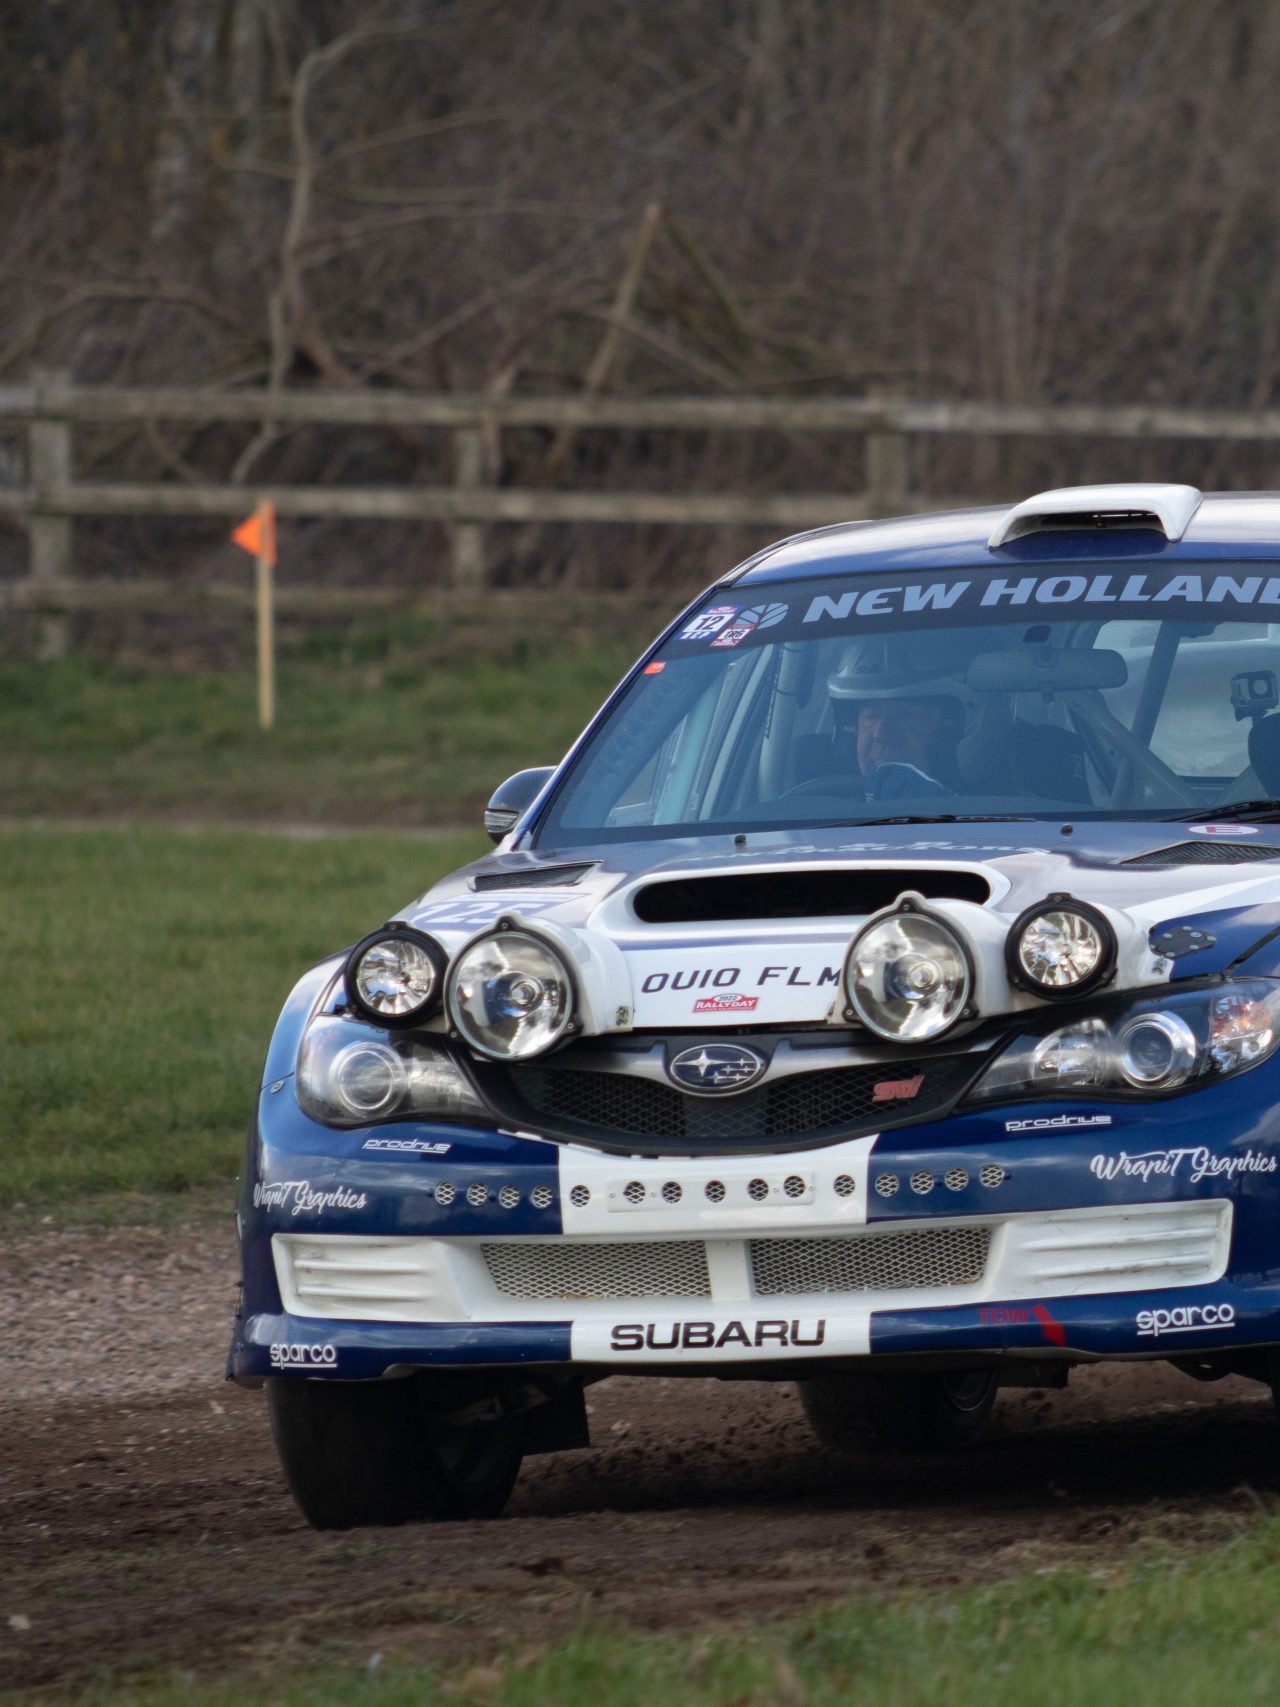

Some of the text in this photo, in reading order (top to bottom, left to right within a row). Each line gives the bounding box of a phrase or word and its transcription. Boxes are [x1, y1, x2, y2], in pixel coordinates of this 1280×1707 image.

[802, 581, 972, 623] NEW
[696, 615, 725, 631] 12
[1005, 1114, 1112, 1132] prodrive
[362, 1138, 451, 1154] prodrive
[1190, 1146, 1278, 1184] Graphics
[292, 1180, 367, 1216] Graphics
[976, 1307, 1031, 1326] TOW
[1136, 1303, 1236, 1336] sparco
[610, 1319, 826, 1351] SUBARU
[270, 1343, 338, 1368] sparco
